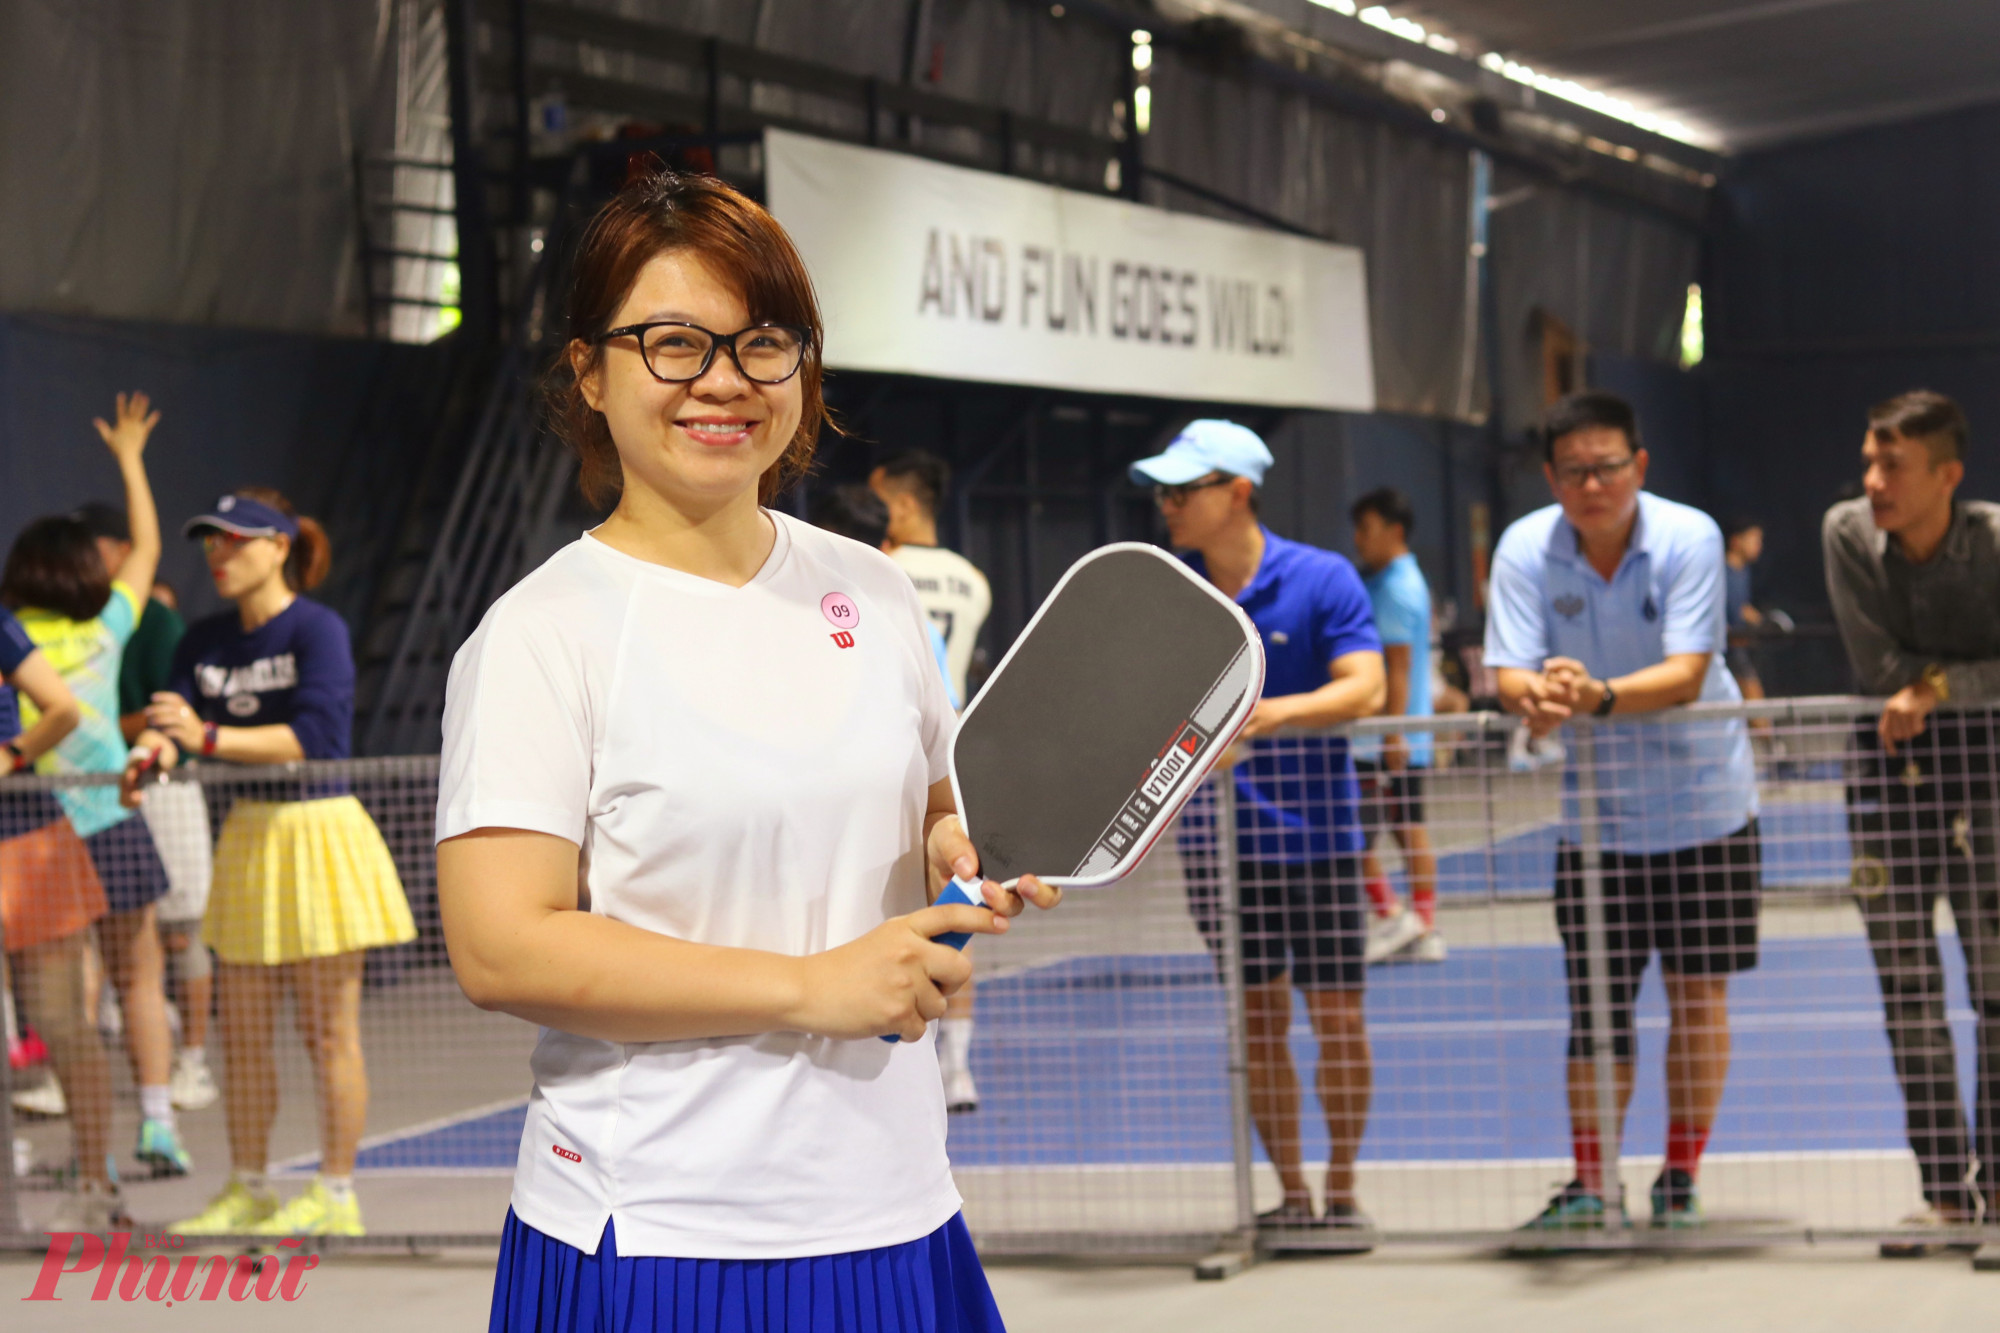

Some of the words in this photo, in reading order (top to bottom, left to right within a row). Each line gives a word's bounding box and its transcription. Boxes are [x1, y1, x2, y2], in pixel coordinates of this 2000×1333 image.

[918, 226, 1005, 323] AND
[1020, 244, 1098, 335] FUN
[1108, 260, 1197, 347] GOES
[831, 604, 850, 618] 09
[1146, 750, 1185, 798] JOOLA
